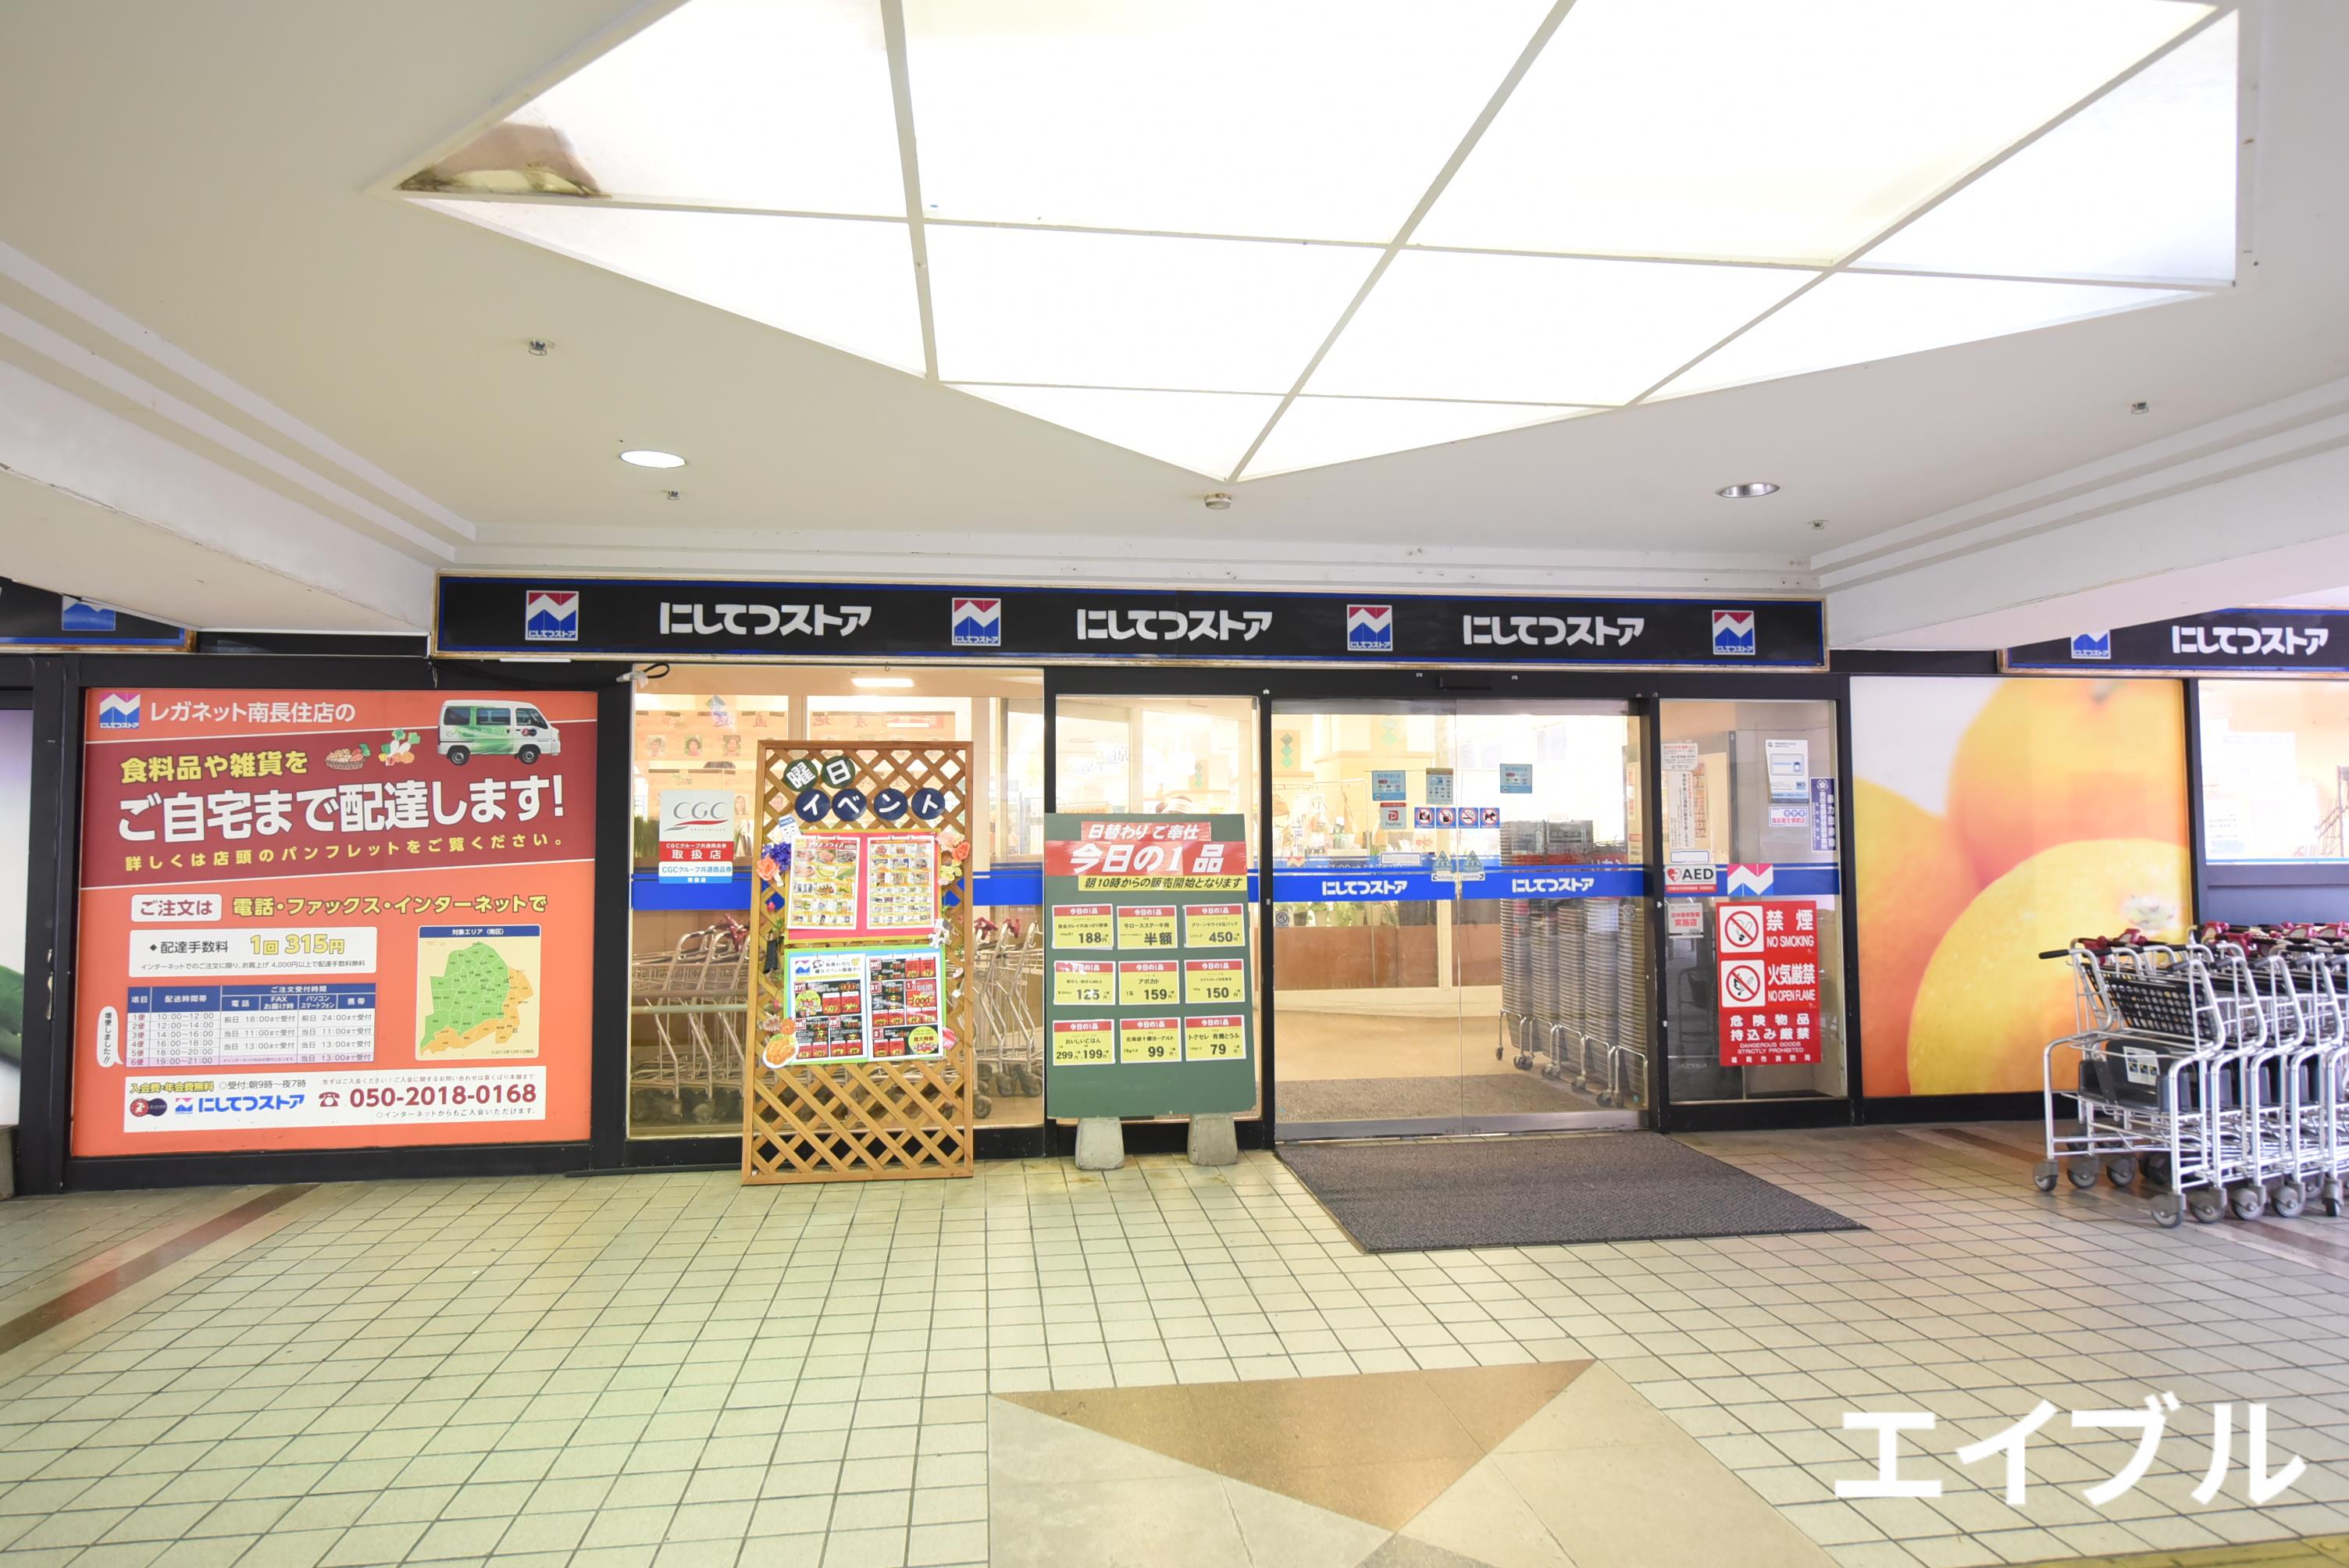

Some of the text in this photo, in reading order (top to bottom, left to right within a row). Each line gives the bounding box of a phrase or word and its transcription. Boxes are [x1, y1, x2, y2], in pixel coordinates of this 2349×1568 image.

[660, 602, 872, 637] にしてつストア
[1077, 609, 1273, 641] にしてつストア
[1463, 615, 1645, 647] にしてつストア
[1350, 640, 1391, 649] にしてつストア
[2172, 625, 2329, 656] にしてつストア
[150, 700, 355, 722] レガネット南長住店の
[121, 750, 307, 784] 食料品や雑貨を
[786, 759, 851, 789] 曜日
[118, 775, 564, 843] ご自宅まで配達します!
[673, 801, 729, 819] CGC
[802, 793, 939, 817] イベント
[126, 833, 563, 872] 詳しくは店頭のパンフレットをご覧ください。
[672, 850, 722, 860] 取扱店
[1070, 843, 1225, 874] 今日の1品
[1681, 868, 1714, 880] AED
[1084, 877, 1243, 889] 朝10時からの販売開始となります
[1321, 880, 1407, 896] にしてつストア
[1512, 877, 1595, 893] にしてつストア
[141, 900, 212, 916] ご注文は
[233, 895, 548, 917] 電話・ファックス・インターネットで
[1766, 908, 1814, 932] 禁煙
[1078, 932, 1101, 943] 188
[1144, 932, 1172, 946] 半額
[1209, 932, 1233, 943] 450
[1766, 935, 1814, 948] NO SMOKING
[160, 941, 228, 953] 配達手数料
[1767, 963, 1816, 985] 火気厳禁
[165, 995, 207, 1003] 配送時間帯
[1144, 989, 1167, 1000] 159
[1207, 987, 1229, 998] 150
[1768, 989, 1816, 1003] NO OPEN FLAME
[1730, 1013, 1810, 1027] 危険物品
[1730, 1027, 1810, 1042] 持込み厳禁
[1083, 1049, 1103, 1059] 199
[1148, 1046, 1164, 1057] 99
[1210, 1043, 1226, 1055] 79
[198, 1094, 305, 1113] にしてつストア
[349, 1084, 536, 1108] 050-2018-0168
